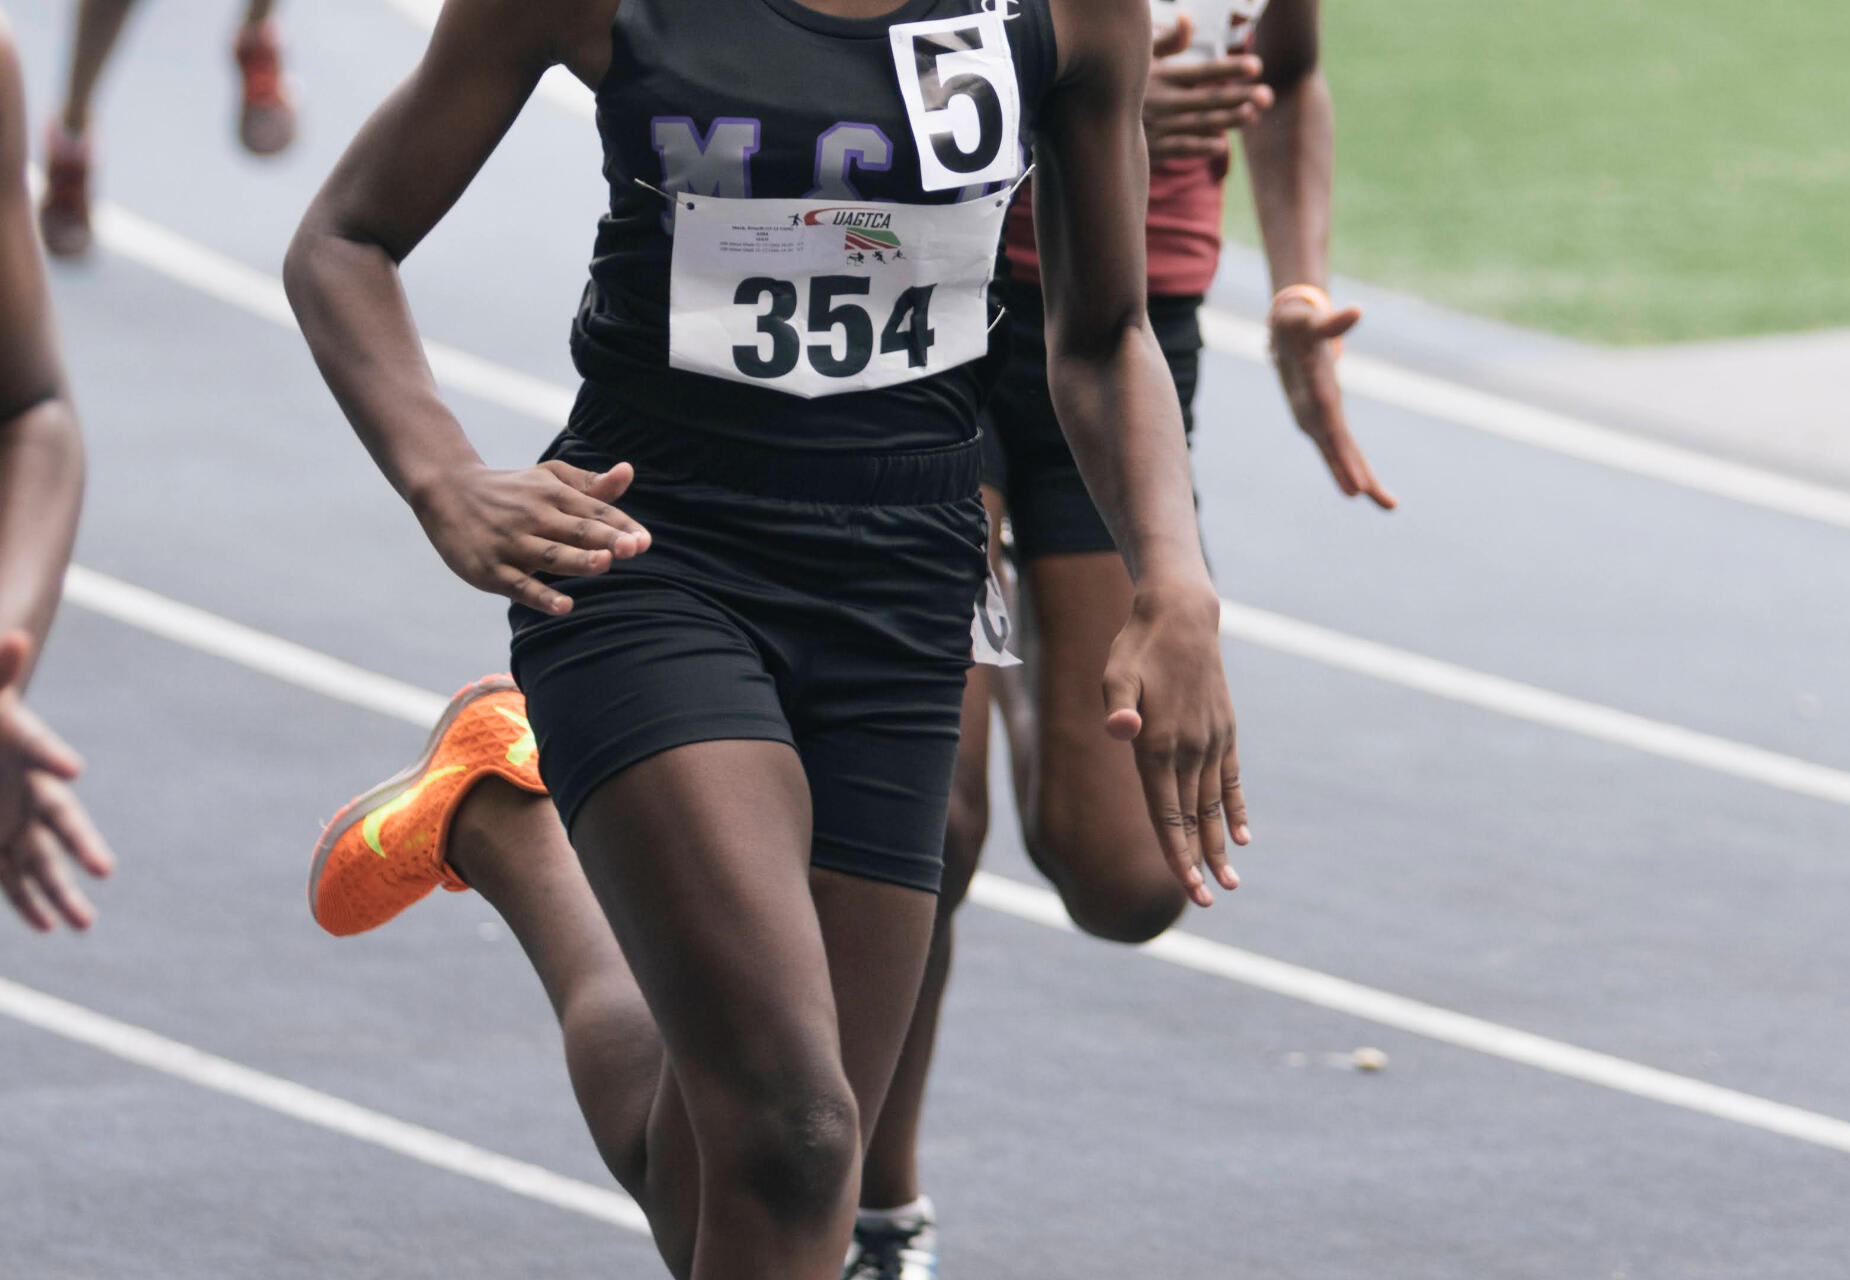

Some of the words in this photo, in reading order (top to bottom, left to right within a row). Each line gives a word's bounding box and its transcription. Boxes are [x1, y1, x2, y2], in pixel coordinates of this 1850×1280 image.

[912, 26, 1003, 174] 5
[832, 211, 892, 229] UAGTCA
[731, 274, 938, 380] 354
